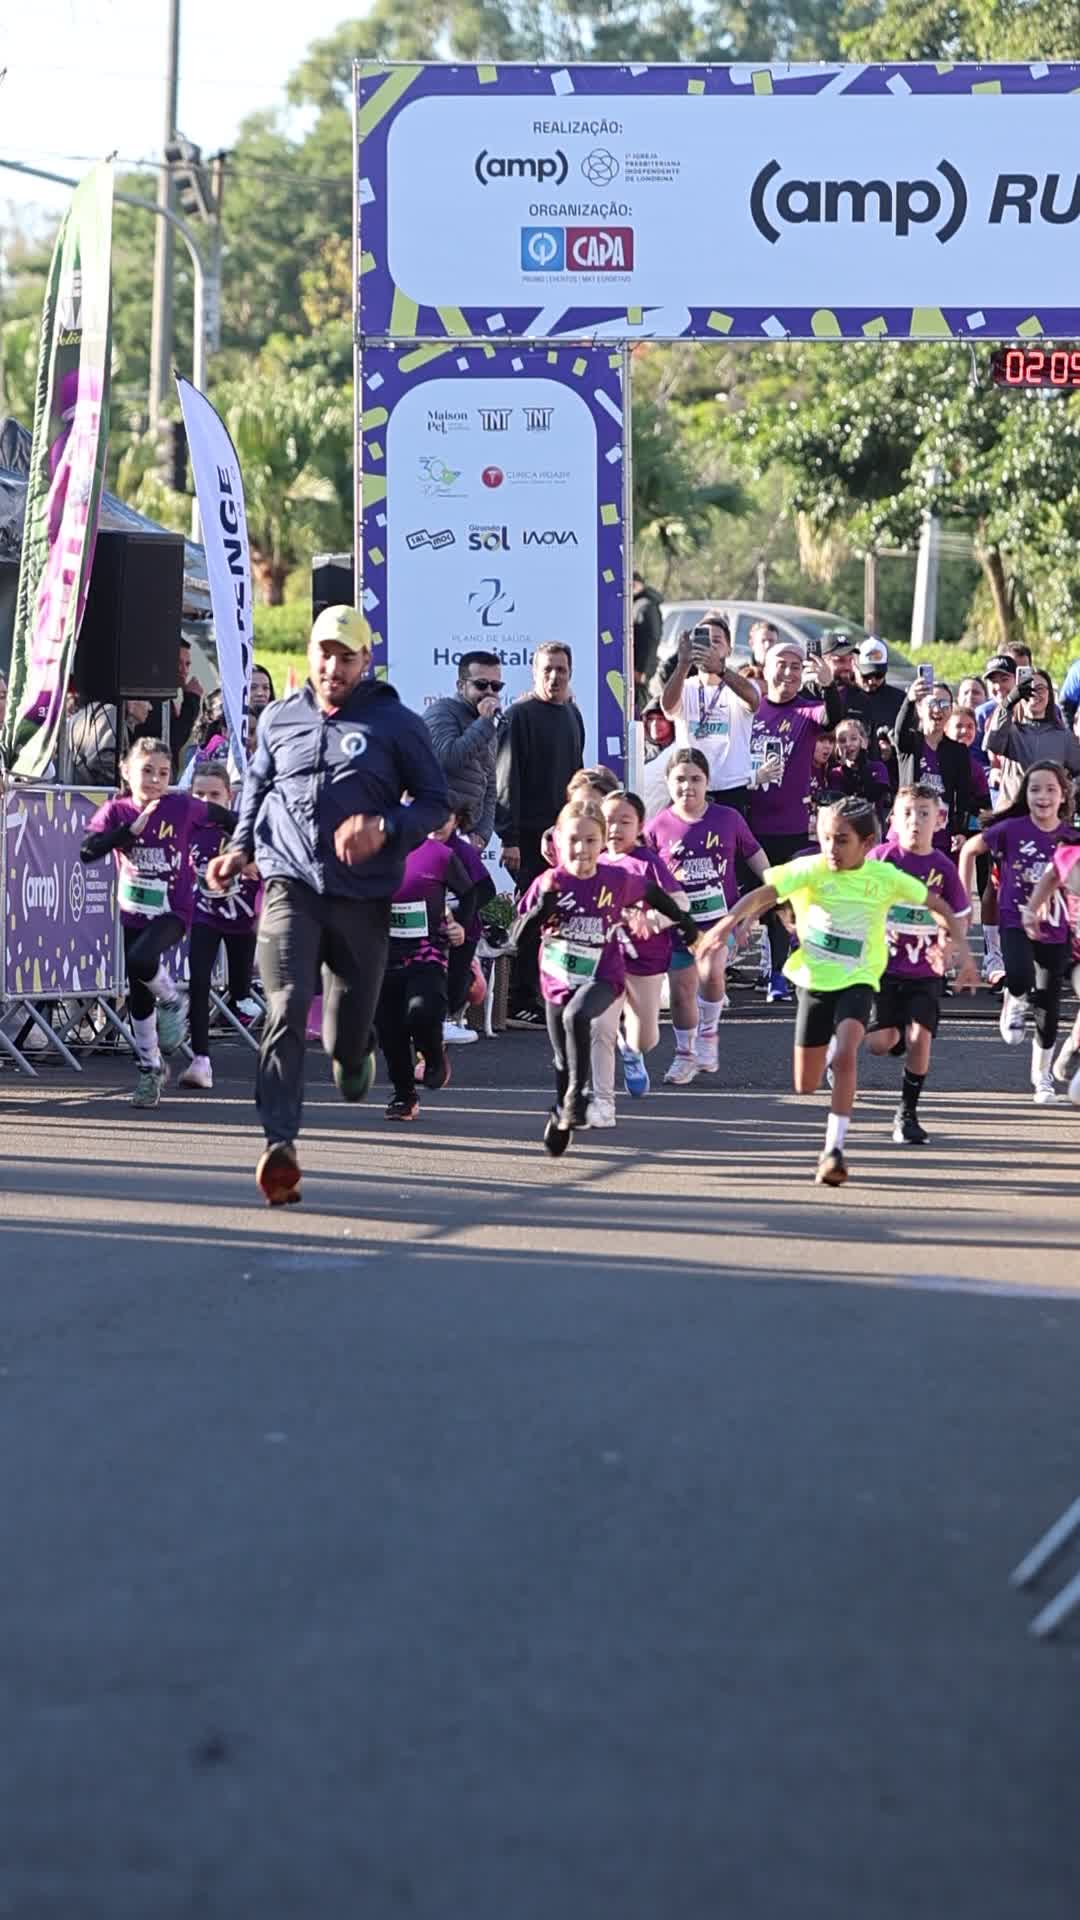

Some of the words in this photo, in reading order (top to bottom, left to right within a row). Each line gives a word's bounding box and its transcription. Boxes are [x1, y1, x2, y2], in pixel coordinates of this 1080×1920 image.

[532, 119, 624, 136] REALIZAÇÃO:
[474, 149, 569, 187] (amp)
[528, 200, 633, 220] ORGANIZAÇÃO:
[749, 158, 968, 244] (amp)
[572, 231, 625, 267] CAPA
[477, 408, 513, 431] TNT
[522, 407, 555, 429] TNT
[480, 850, 497, 860] GE
[22, 863, 59, 922] (amp)
[906, 909, 924, 922] 45
